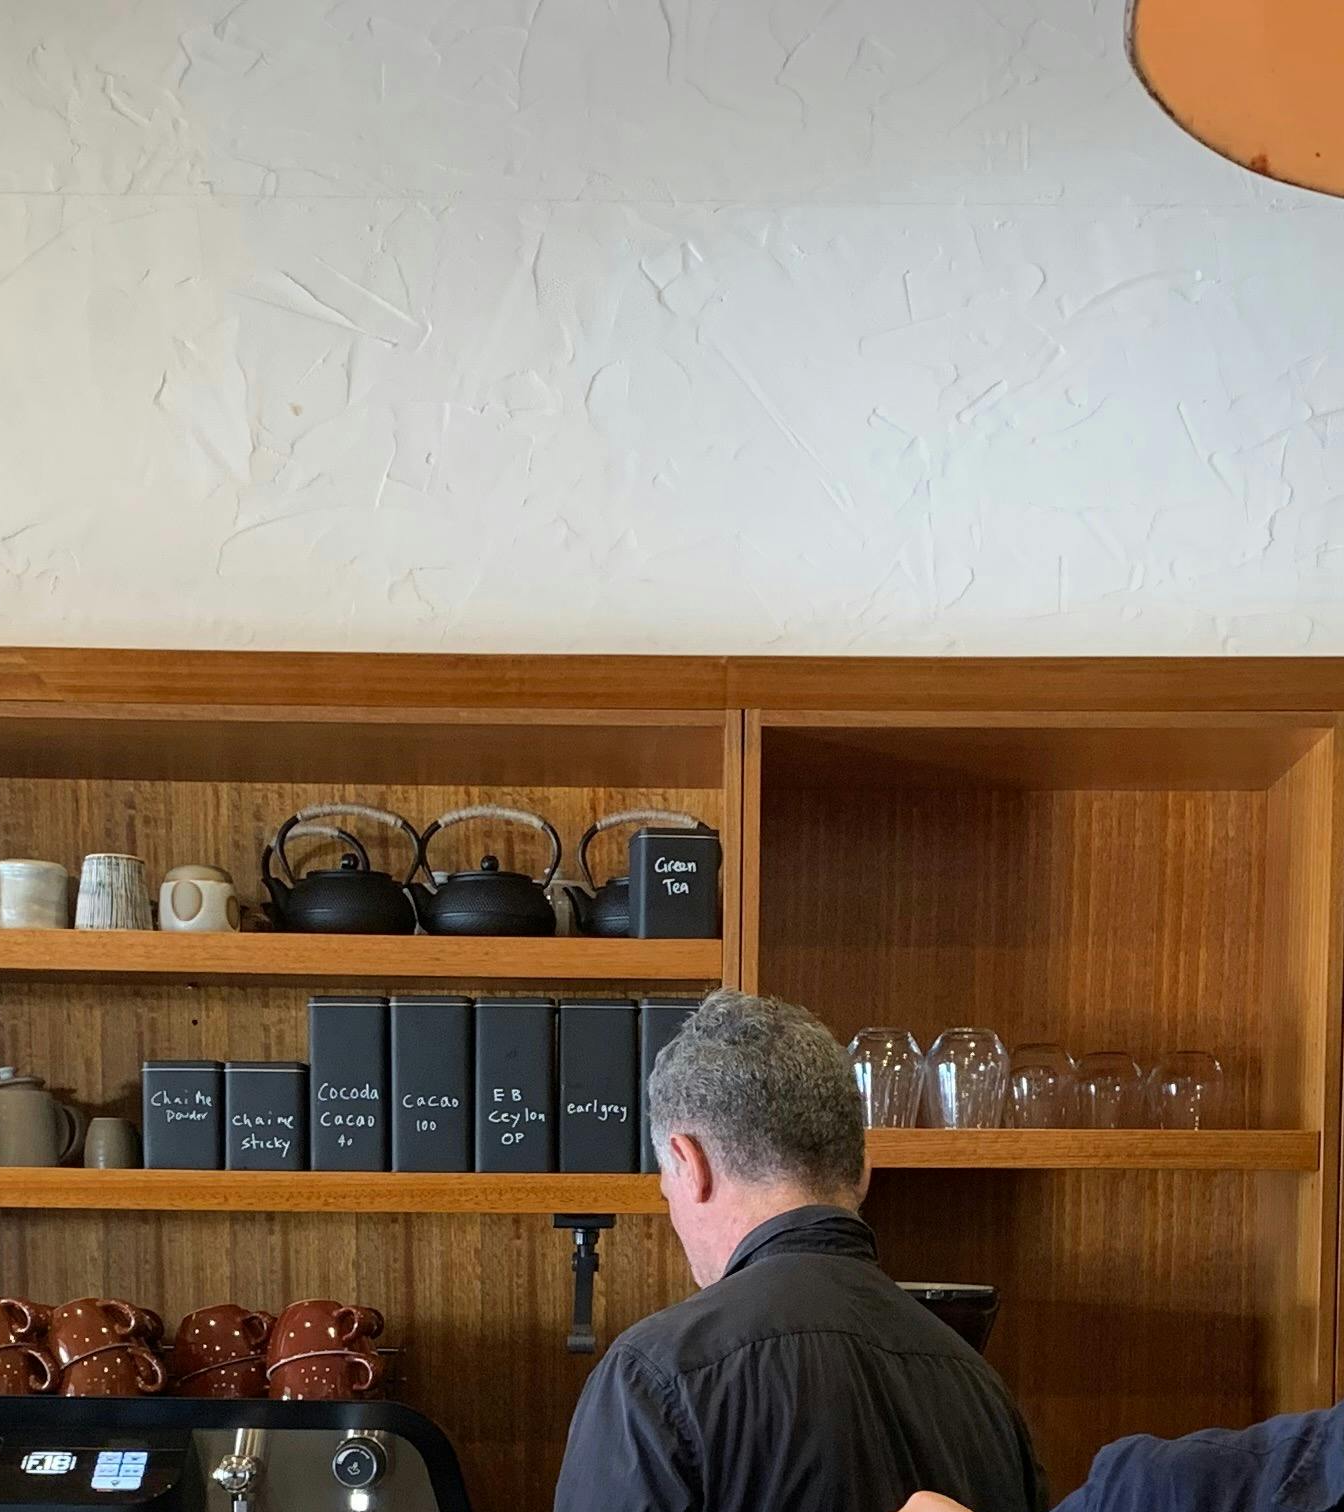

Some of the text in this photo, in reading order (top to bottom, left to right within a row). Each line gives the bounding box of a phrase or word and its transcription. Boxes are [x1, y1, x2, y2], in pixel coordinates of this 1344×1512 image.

[654, 856, 697, 873] Green
[662, 878, 690, 895] Tea
[151, 1089, 189, 1107] Chai
[317, 1083, 380, 1102] Cocoda
[415, 1120, 437, 1132] 100
[488, 1108, 546, 1128] Ceylon
[240, 1132, 291, 1158] sticky
[337, 1134, 353, 1148] 40
[501, 1132, 525, 1145] OP
